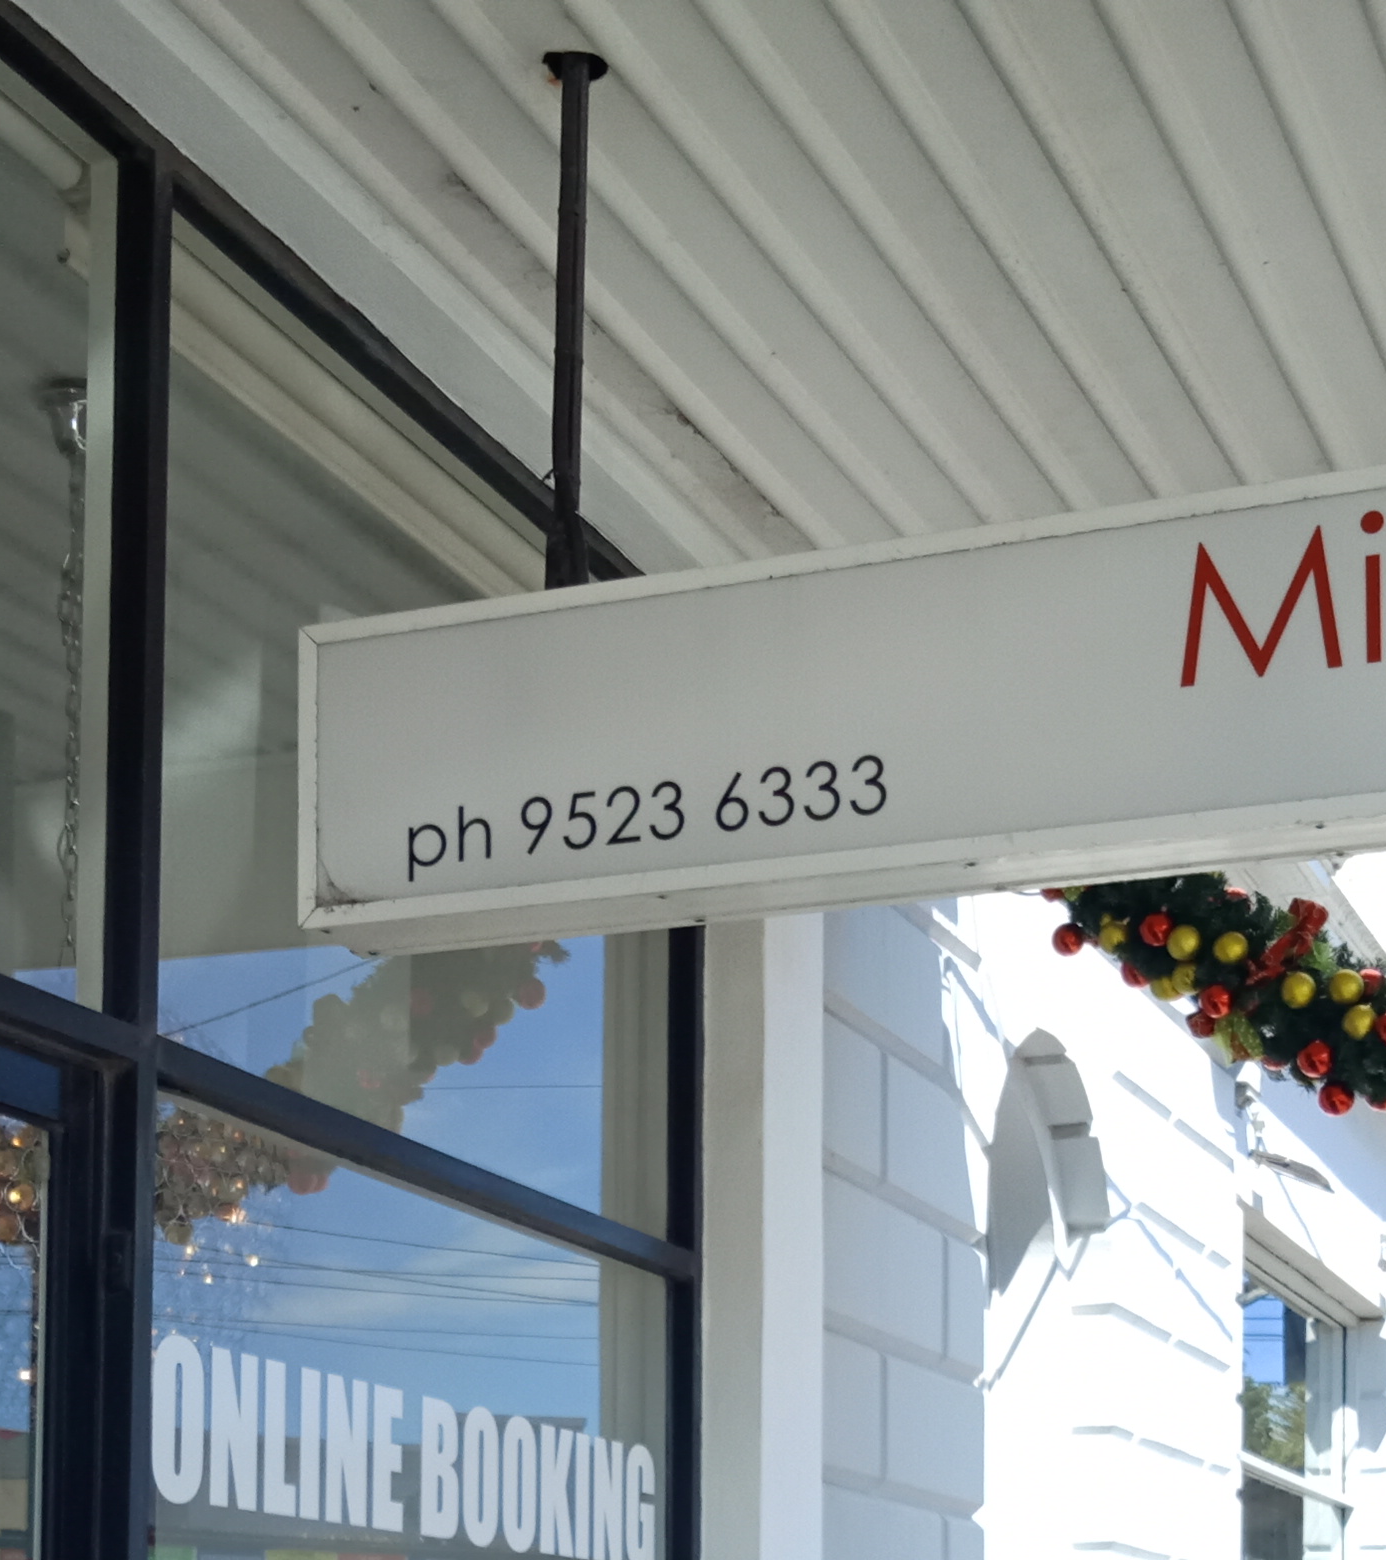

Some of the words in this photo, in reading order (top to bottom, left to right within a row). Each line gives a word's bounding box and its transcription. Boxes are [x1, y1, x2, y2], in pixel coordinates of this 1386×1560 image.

[404, 804, 494, 880] ph
[517, 773, 685, 854] 9523
[715, 752, 889, 834] 6333
[151, 1333, 404, 1532] ONLINE
